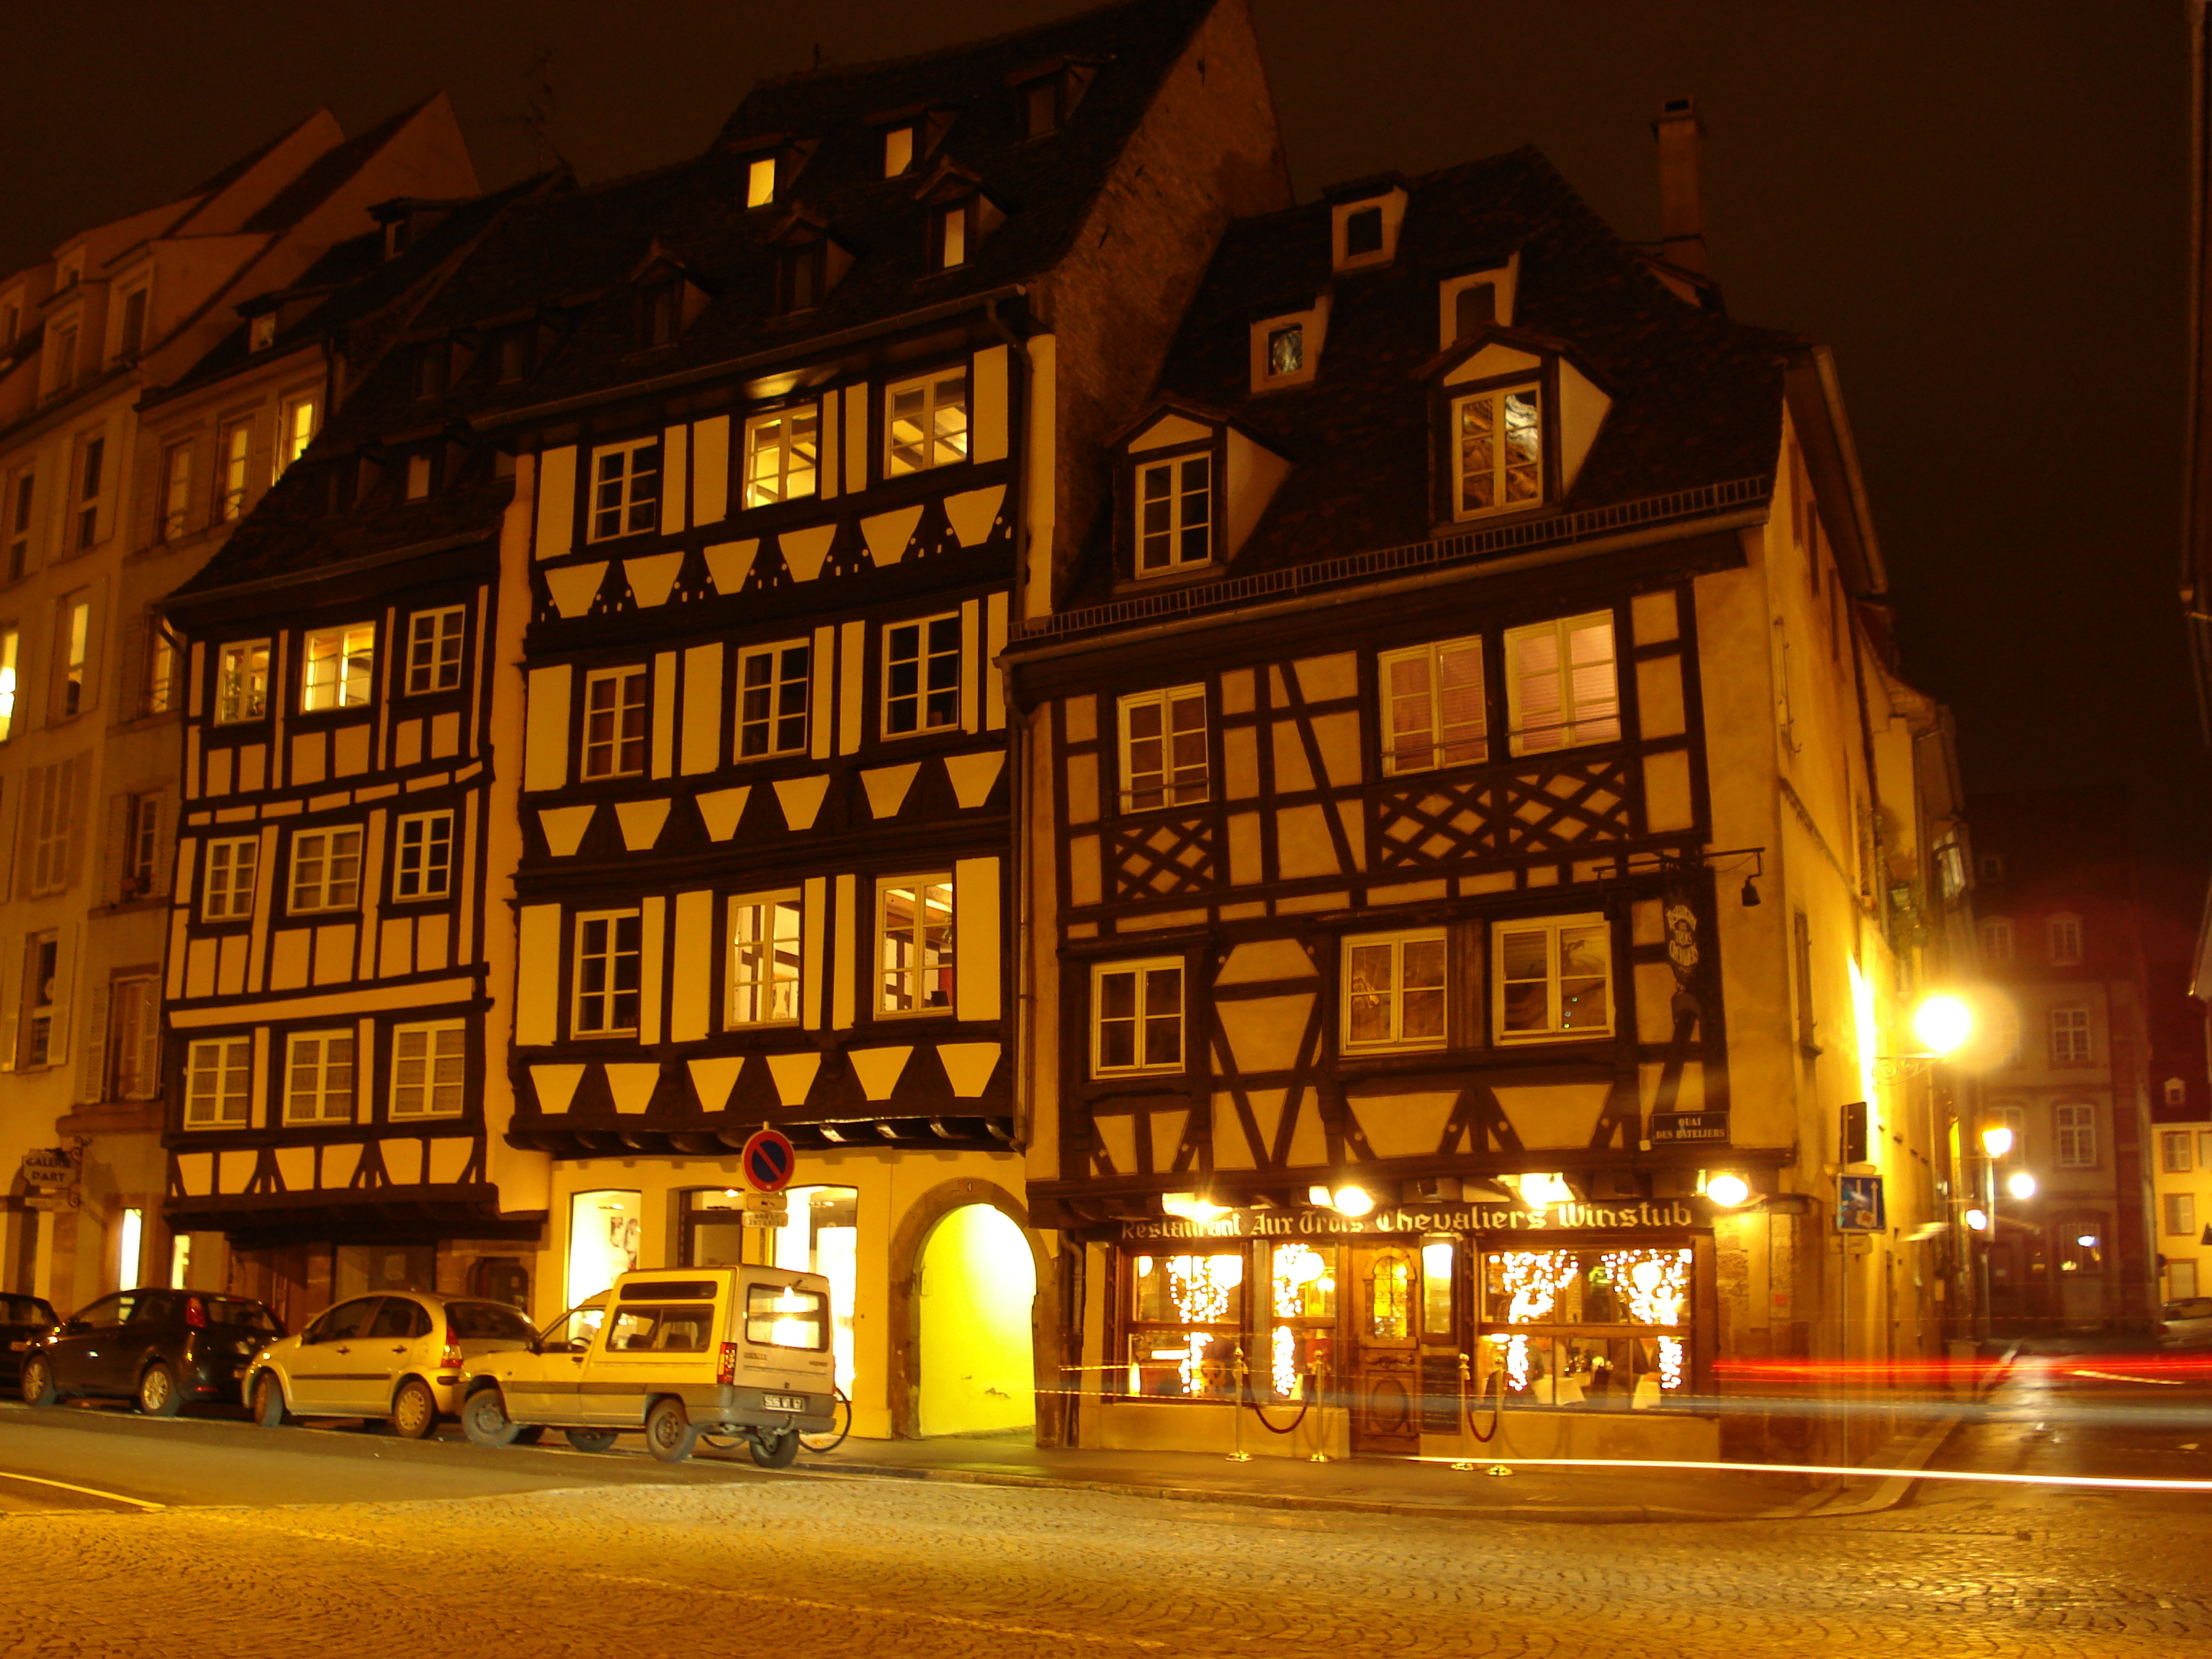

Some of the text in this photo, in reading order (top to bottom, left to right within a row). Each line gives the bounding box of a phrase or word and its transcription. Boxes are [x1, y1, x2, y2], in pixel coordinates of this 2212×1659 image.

[1678, 1118, 1701, 1127] QUAI
[1656, 1129, 1725, 1139] DES BATELIERS
[1122, 1201, 1693, 1238] Restaurant Aux Trois Chevaliers Winstub
